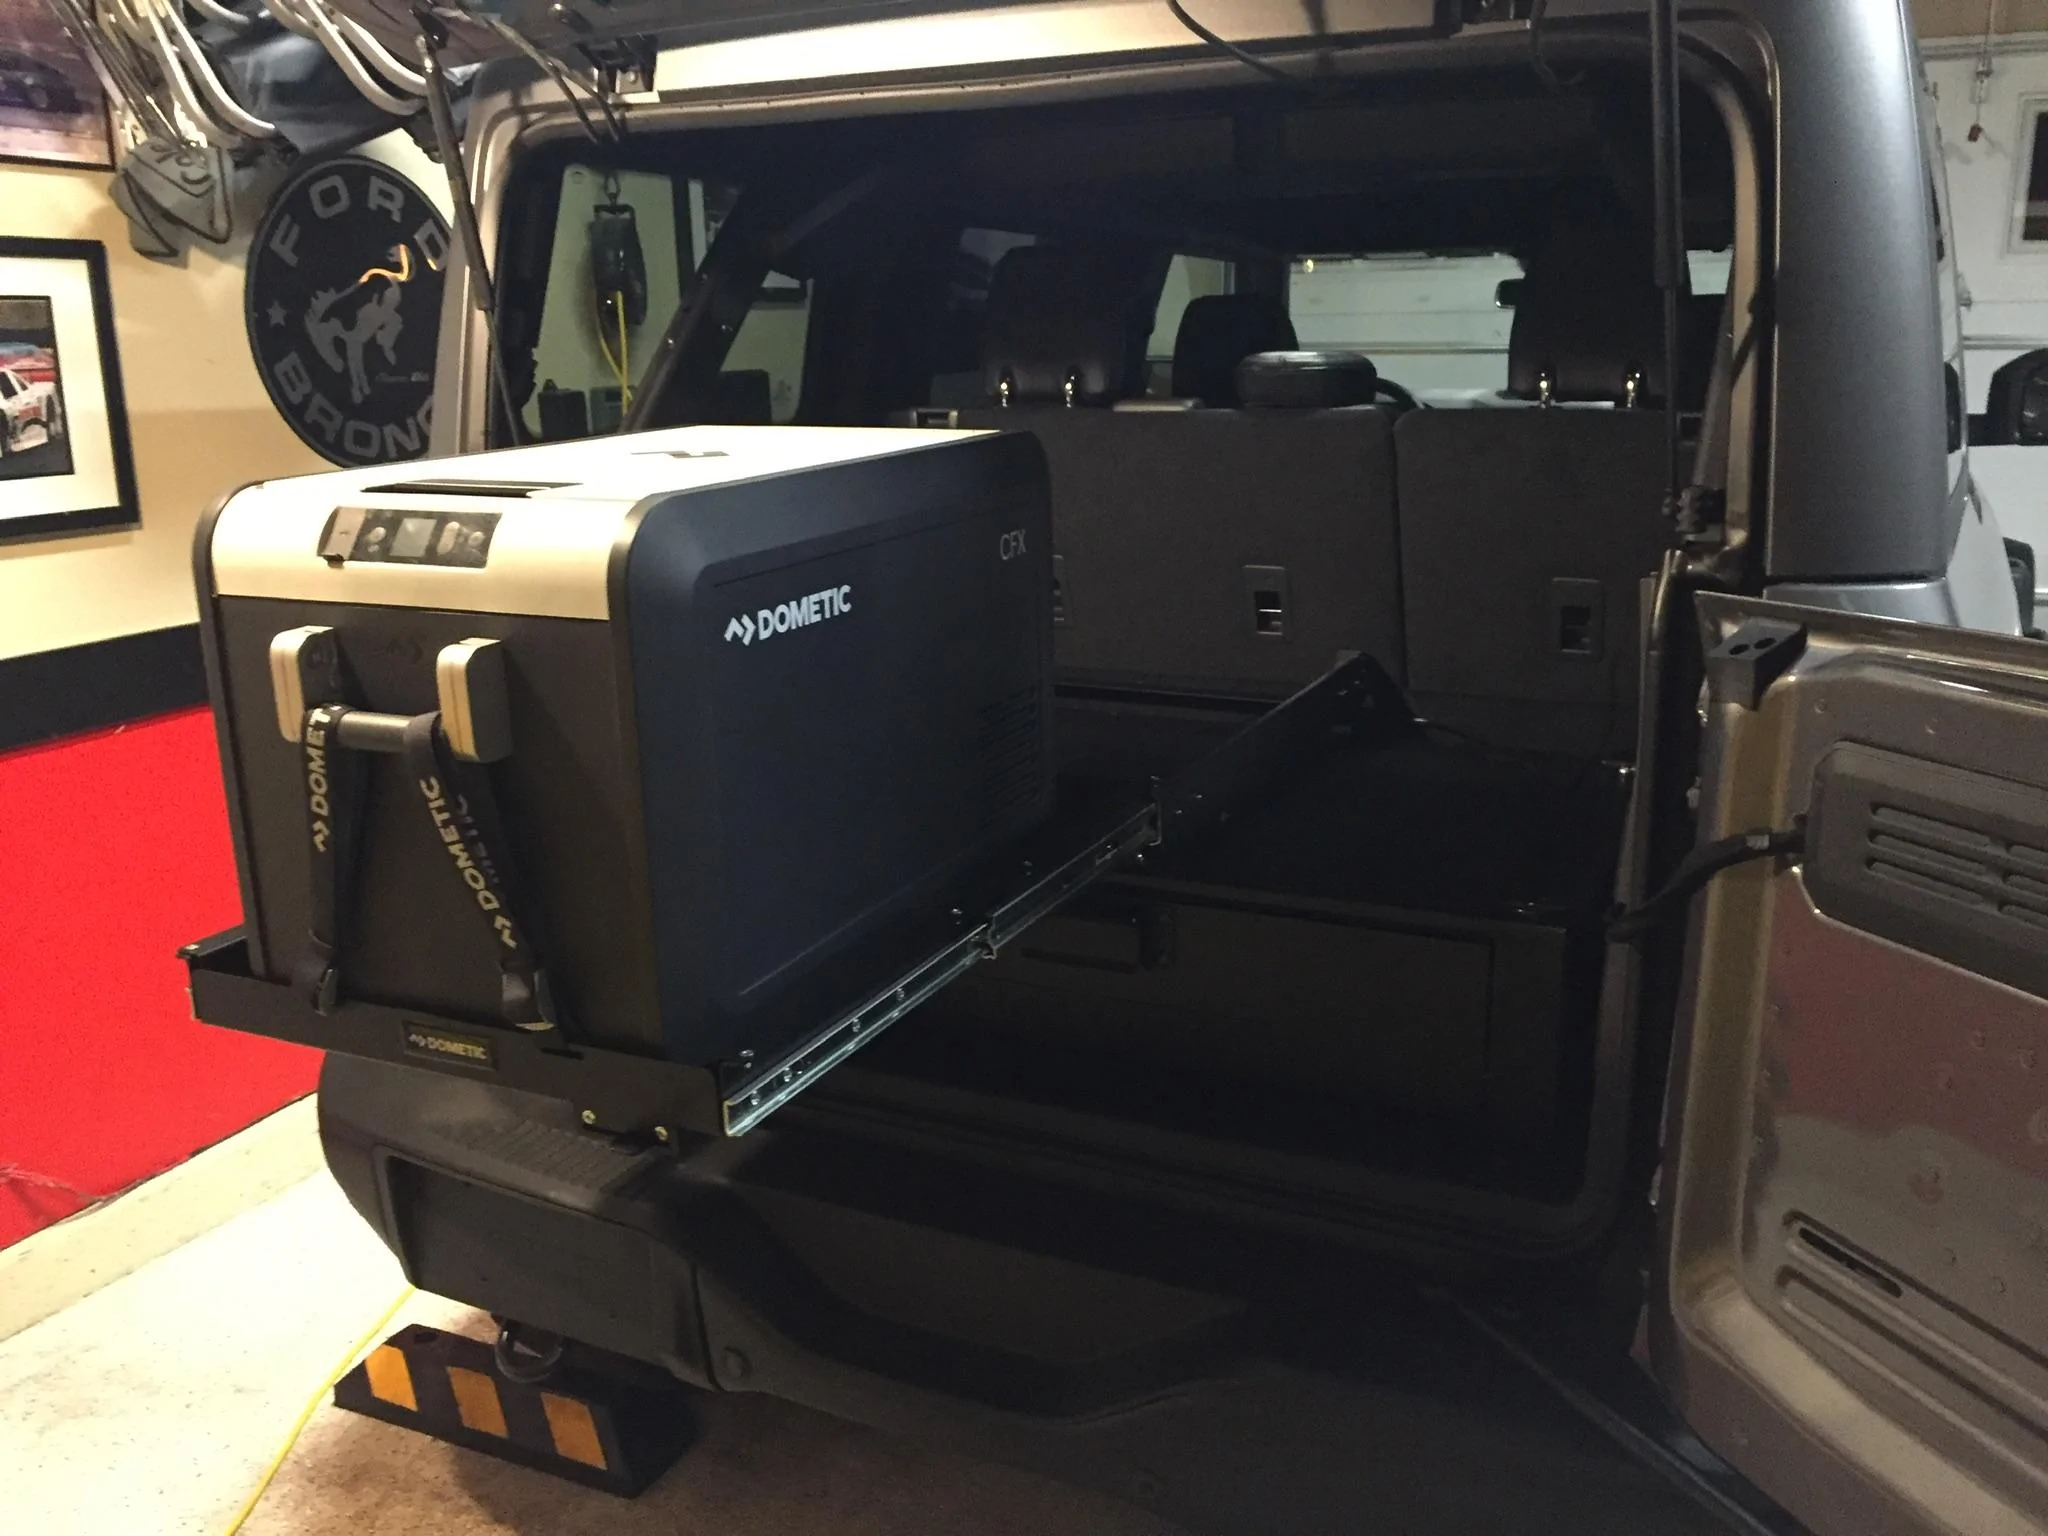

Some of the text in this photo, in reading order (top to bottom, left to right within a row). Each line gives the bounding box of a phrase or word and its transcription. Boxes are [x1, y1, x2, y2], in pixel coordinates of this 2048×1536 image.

[270, 174, 449, 271] FORD
[1000, 529, 1027, 560] CFX
[757, 584, 852, 640] DOMETIC
[306, 707, 331, 817] DOMET
[420, 776, 500, 911] DOMETIC
[427, 1036, 488, 1060] DOMETIC
